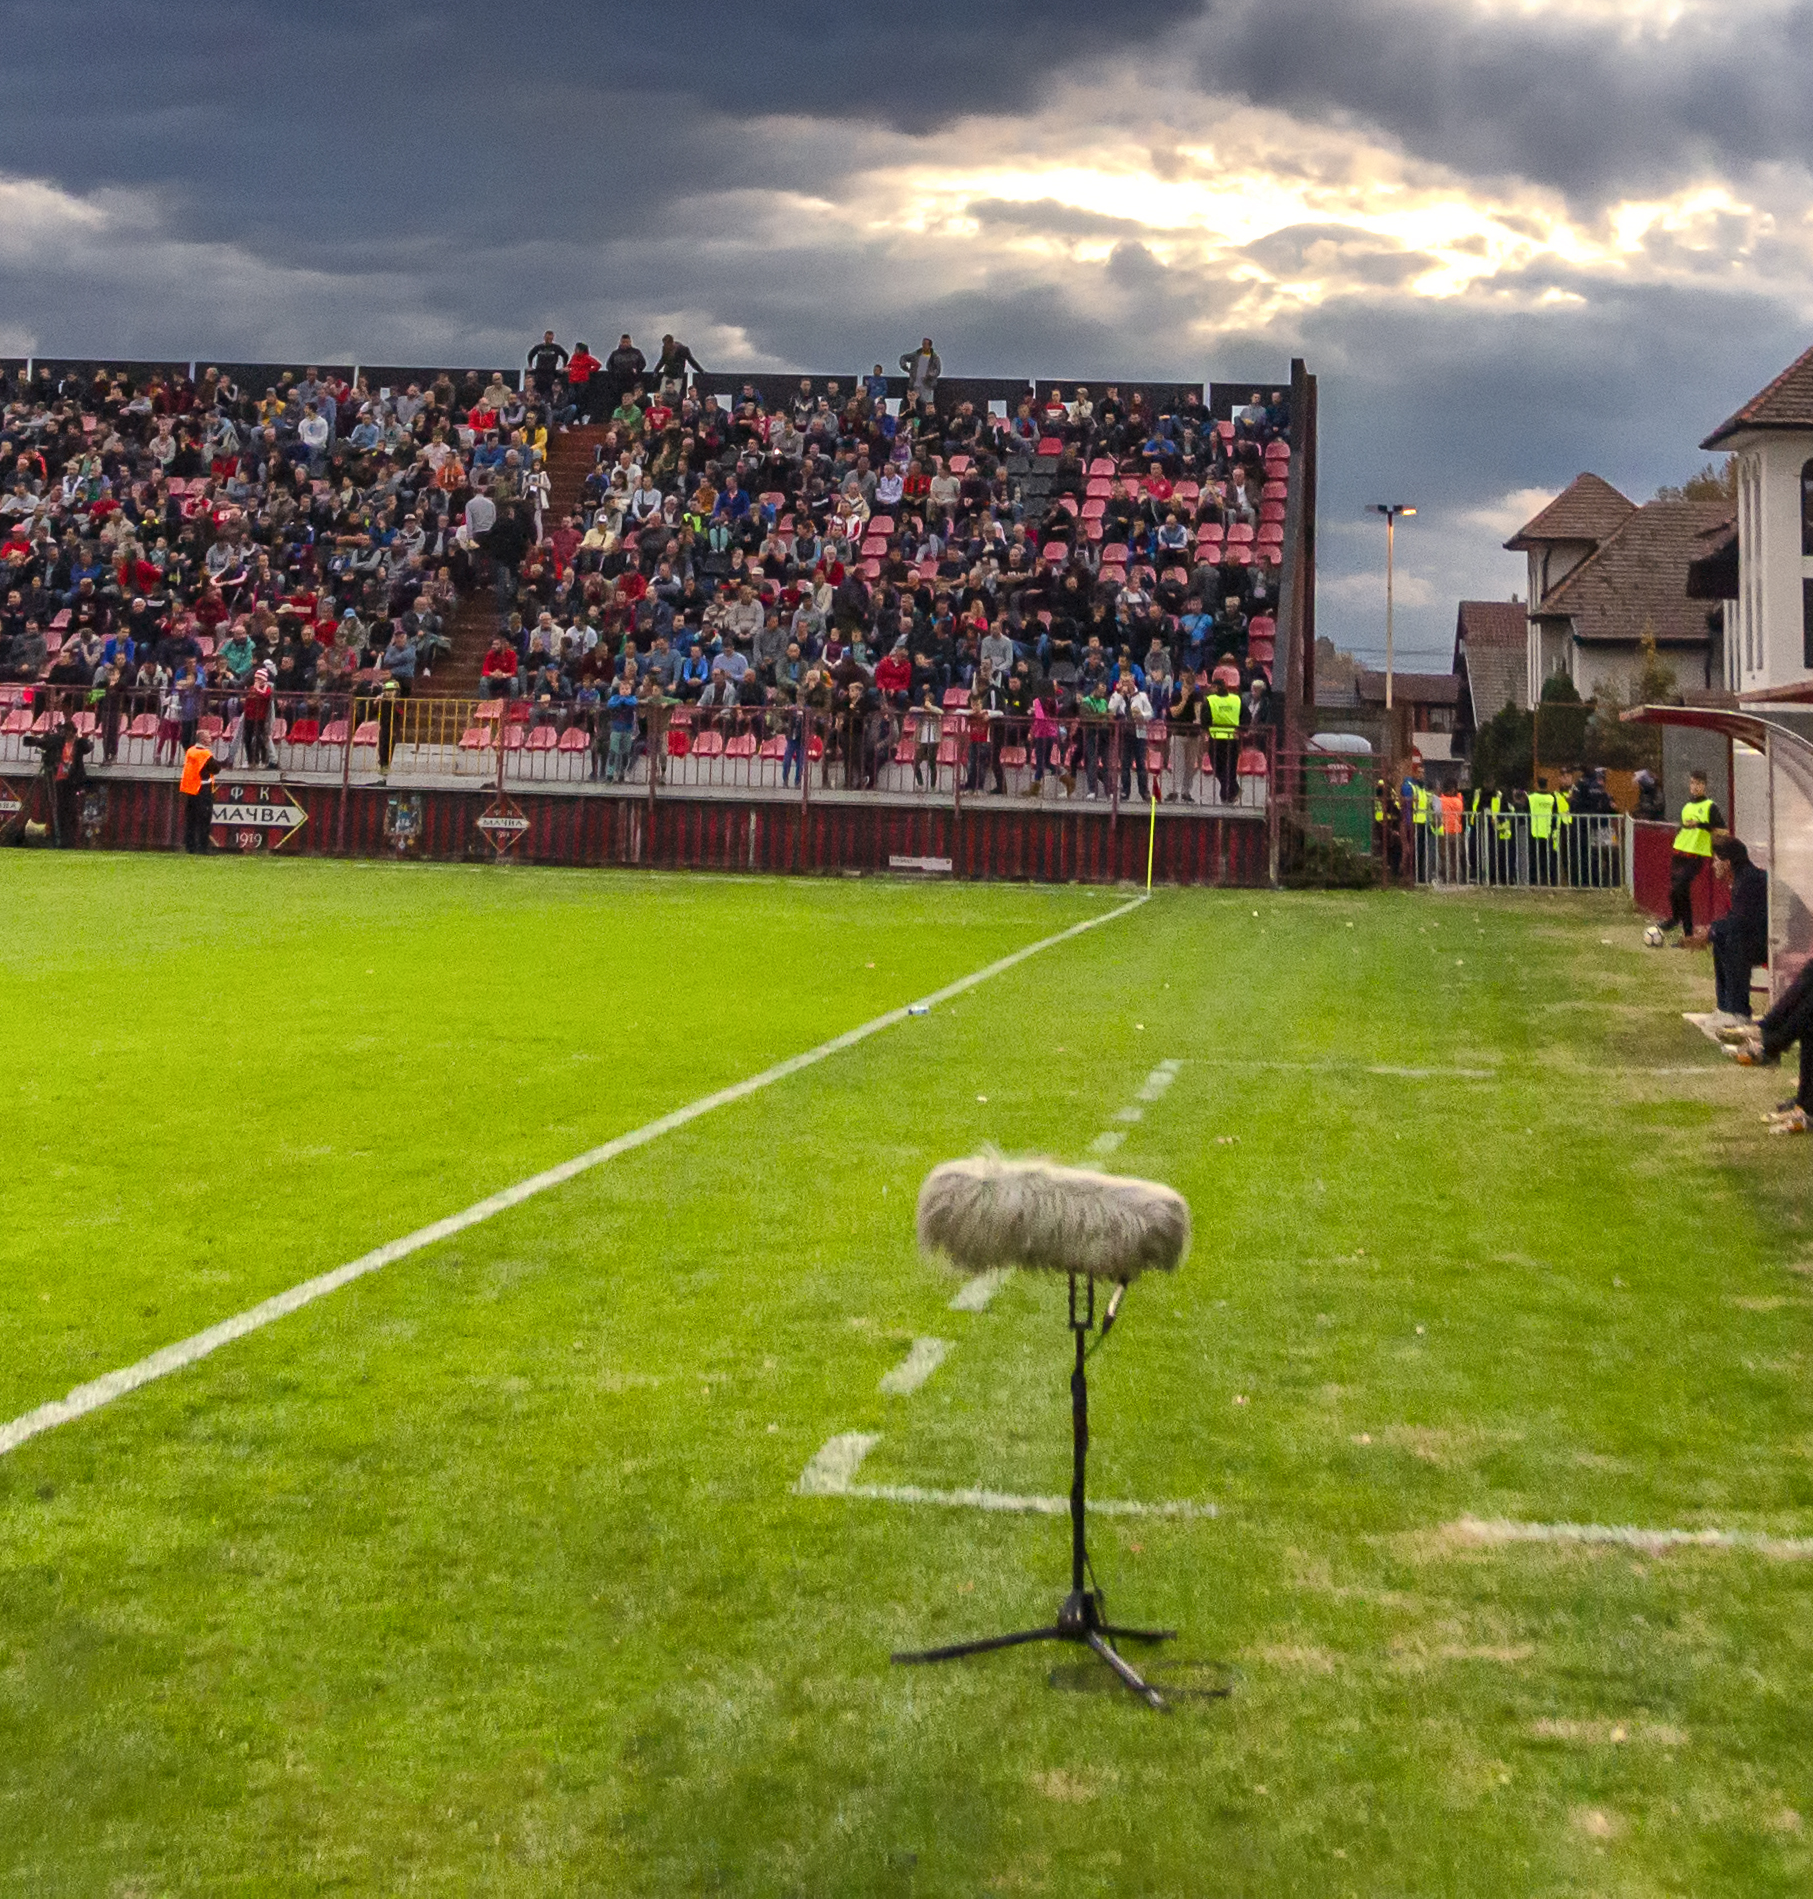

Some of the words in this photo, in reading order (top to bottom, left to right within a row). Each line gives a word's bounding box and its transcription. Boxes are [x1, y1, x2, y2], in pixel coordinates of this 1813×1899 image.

[230, 786, 244, 800] Ф
[259, 786, 270, 801] К
[212, 807, 291, 823] МАЧВА
[235, 831, 263, 849] 1919
